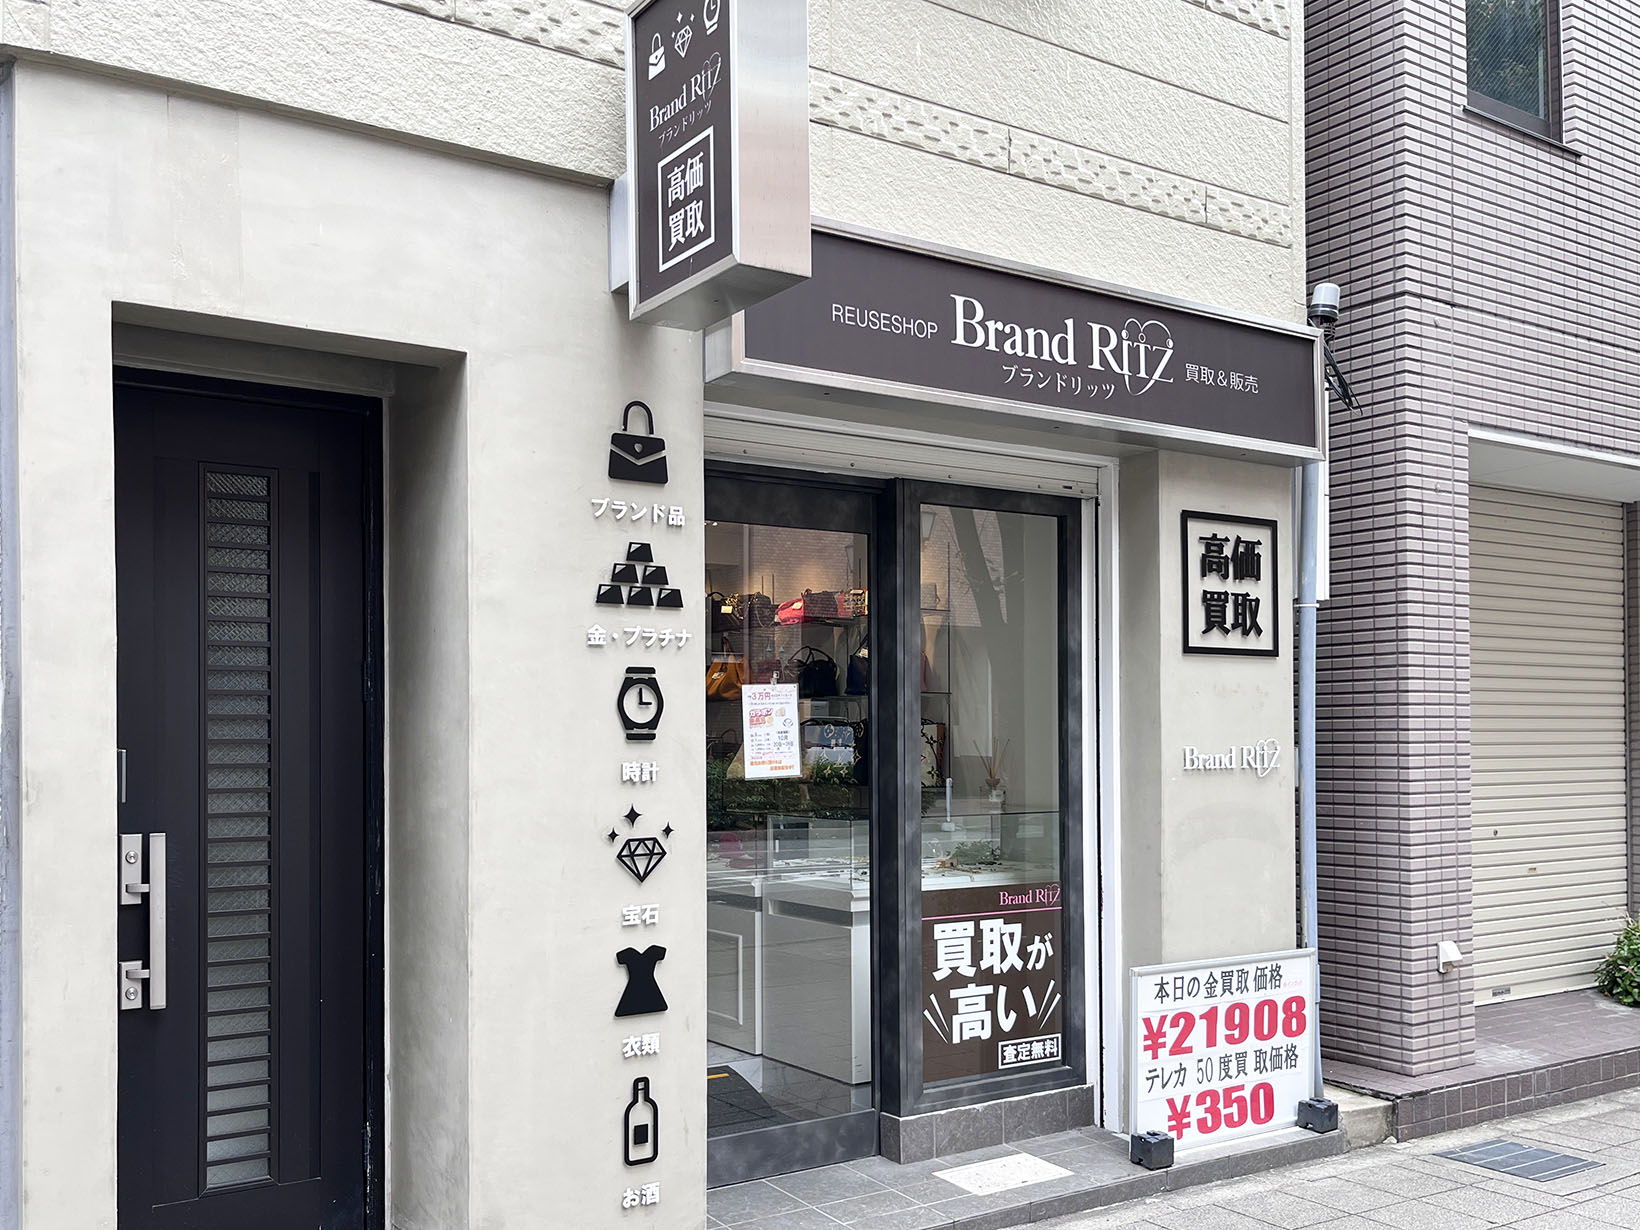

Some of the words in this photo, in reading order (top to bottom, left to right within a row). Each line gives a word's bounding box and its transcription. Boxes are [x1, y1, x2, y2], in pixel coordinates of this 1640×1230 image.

[649, 83, 688, 132] Brand
[658, 99, 712, 148] ブランドリッツ
[667, 151, 704, 208] 高価
[668, 199, 705, 252] 買取
[831, 304, 939, 339] REUSESHOP
[950, 293, 1077, 367] Brand
[1001, 364, 1116, 400] ブランドリッツ
[591, 497, 686, 527] ブランド品
[1198, 532, 1263, 582] 高価
[587, 623, 693, 648] 金・プラチナ
[1201, 589, 1263, 638] 買取
[621, 761, 660, 783] 時計
[1183, 745, 1237, 770] Brand
[622, 904, 660, 926] 宝石
[1000, 889, 1033, 906] Brand
[932, 918, 1054, 982] 買取が
[1153, 963, 1283, 1004] 本日の金買取価格
[949, 983, 1038, 1045] 高い
[1142, 995, 1307, 1060] ¥21908
[622, 1032, 660, 1058] 衣類
[1002, 1037, 1058, 1065] 査定無料
[1166, 1081, 1275, 1141] ¥350
[622, 1182, 661, 1209] お酒
